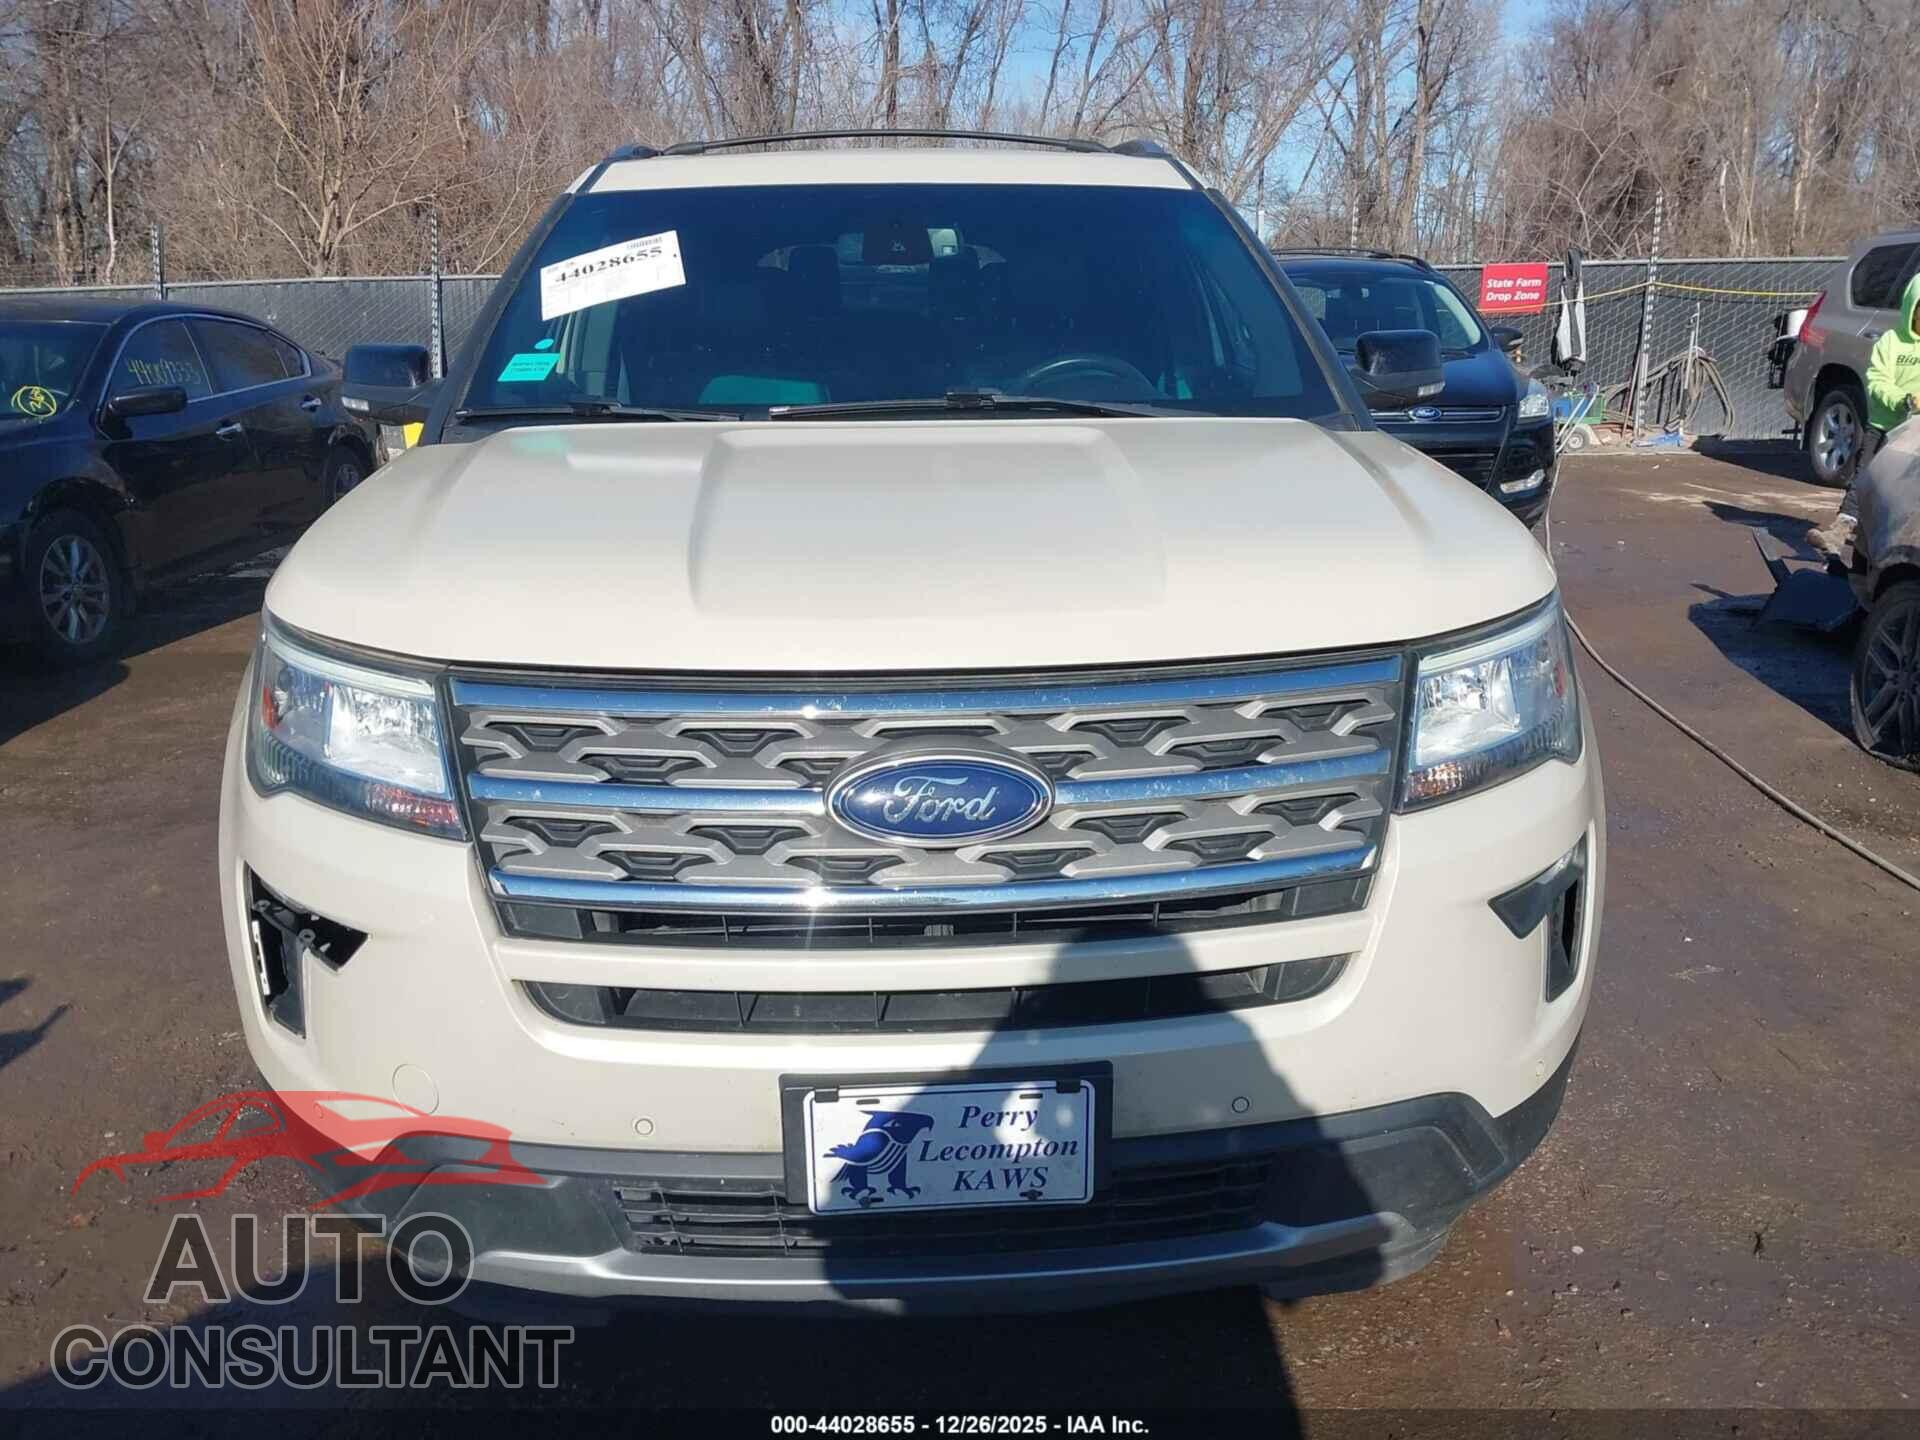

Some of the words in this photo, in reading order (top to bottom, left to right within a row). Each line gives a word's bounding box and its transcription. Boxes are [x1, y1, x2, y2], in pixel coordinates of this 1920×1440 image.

[555, 245, 663, 284] 44028655
[1487, 278, 1514, 288] State
[1515, 277, 1542, 287] Farm
[1486, 292, 1512, 303] Drop
[1513, 291, 1540, 300] Zone
[882, 775, 998, 824] Ford
[959, 1105, 1040, 1132] Perry
[918, 1138, 1080, 1164] Lecompton
[952, 1166, 1050, 1192] KAWS
